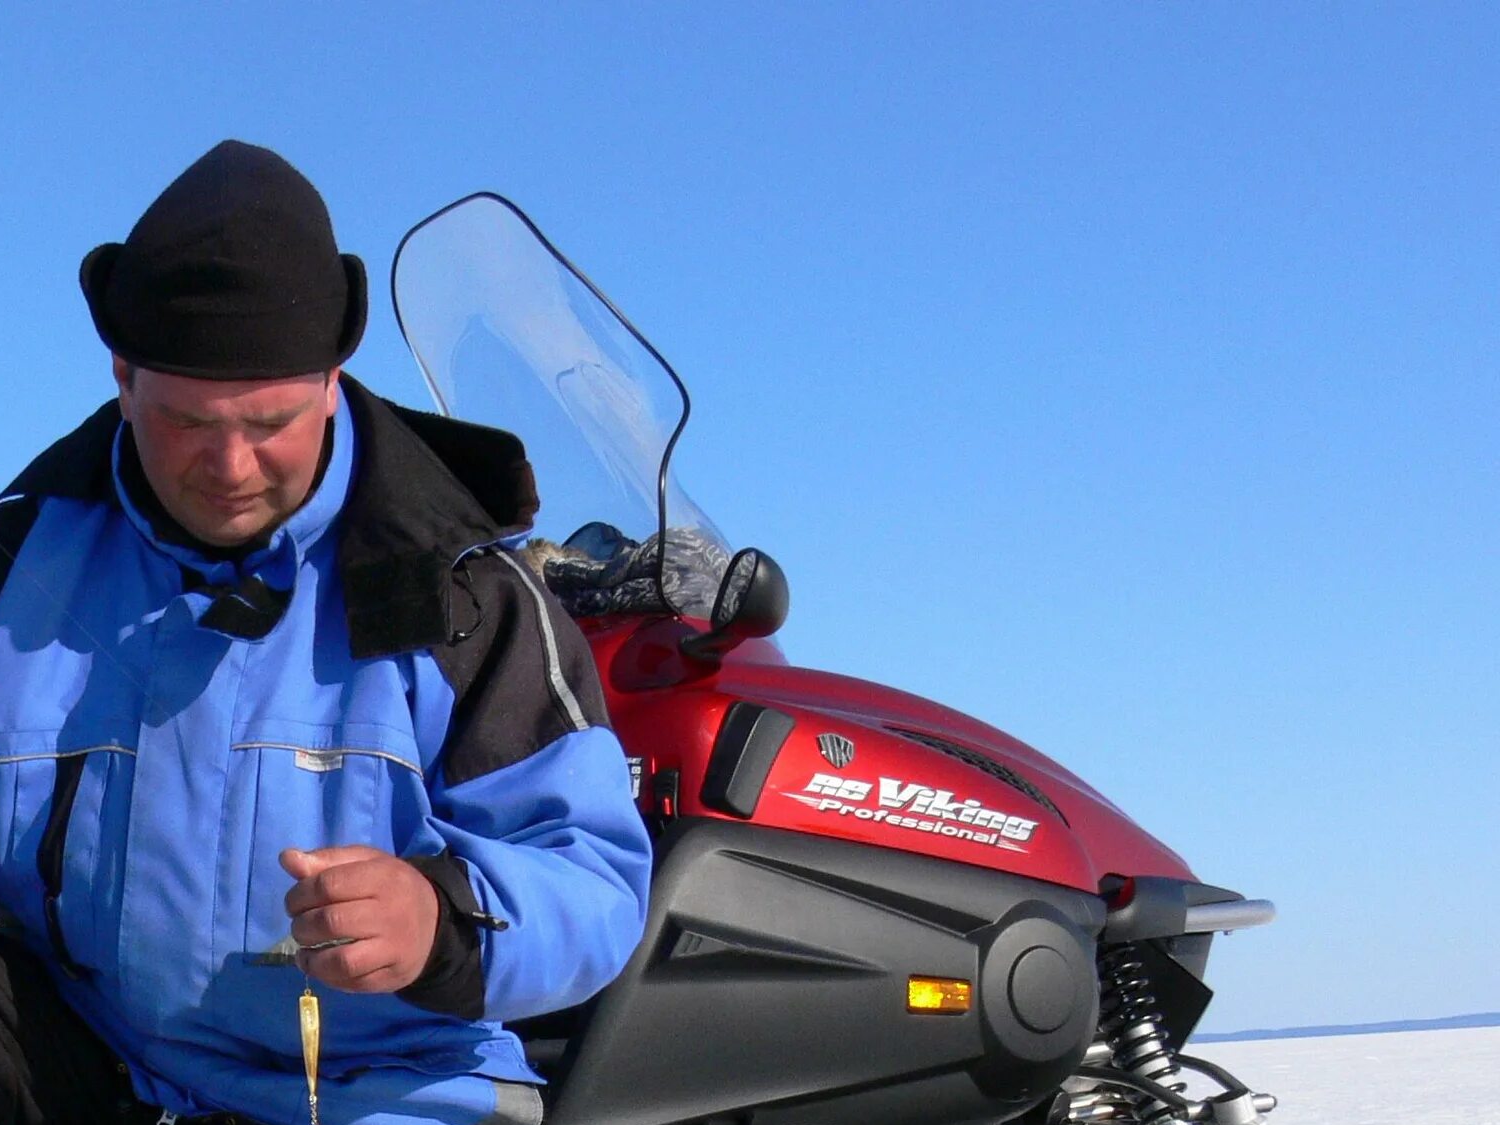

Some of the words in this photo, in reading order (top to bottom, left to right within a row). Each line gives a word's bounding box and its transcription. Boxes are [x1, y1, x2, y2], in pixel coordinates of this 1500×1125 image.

[803, 773, 874, 801] RS
[878, 777, 1040, 841] Viking
[818, 799, 998, 845] Professional
